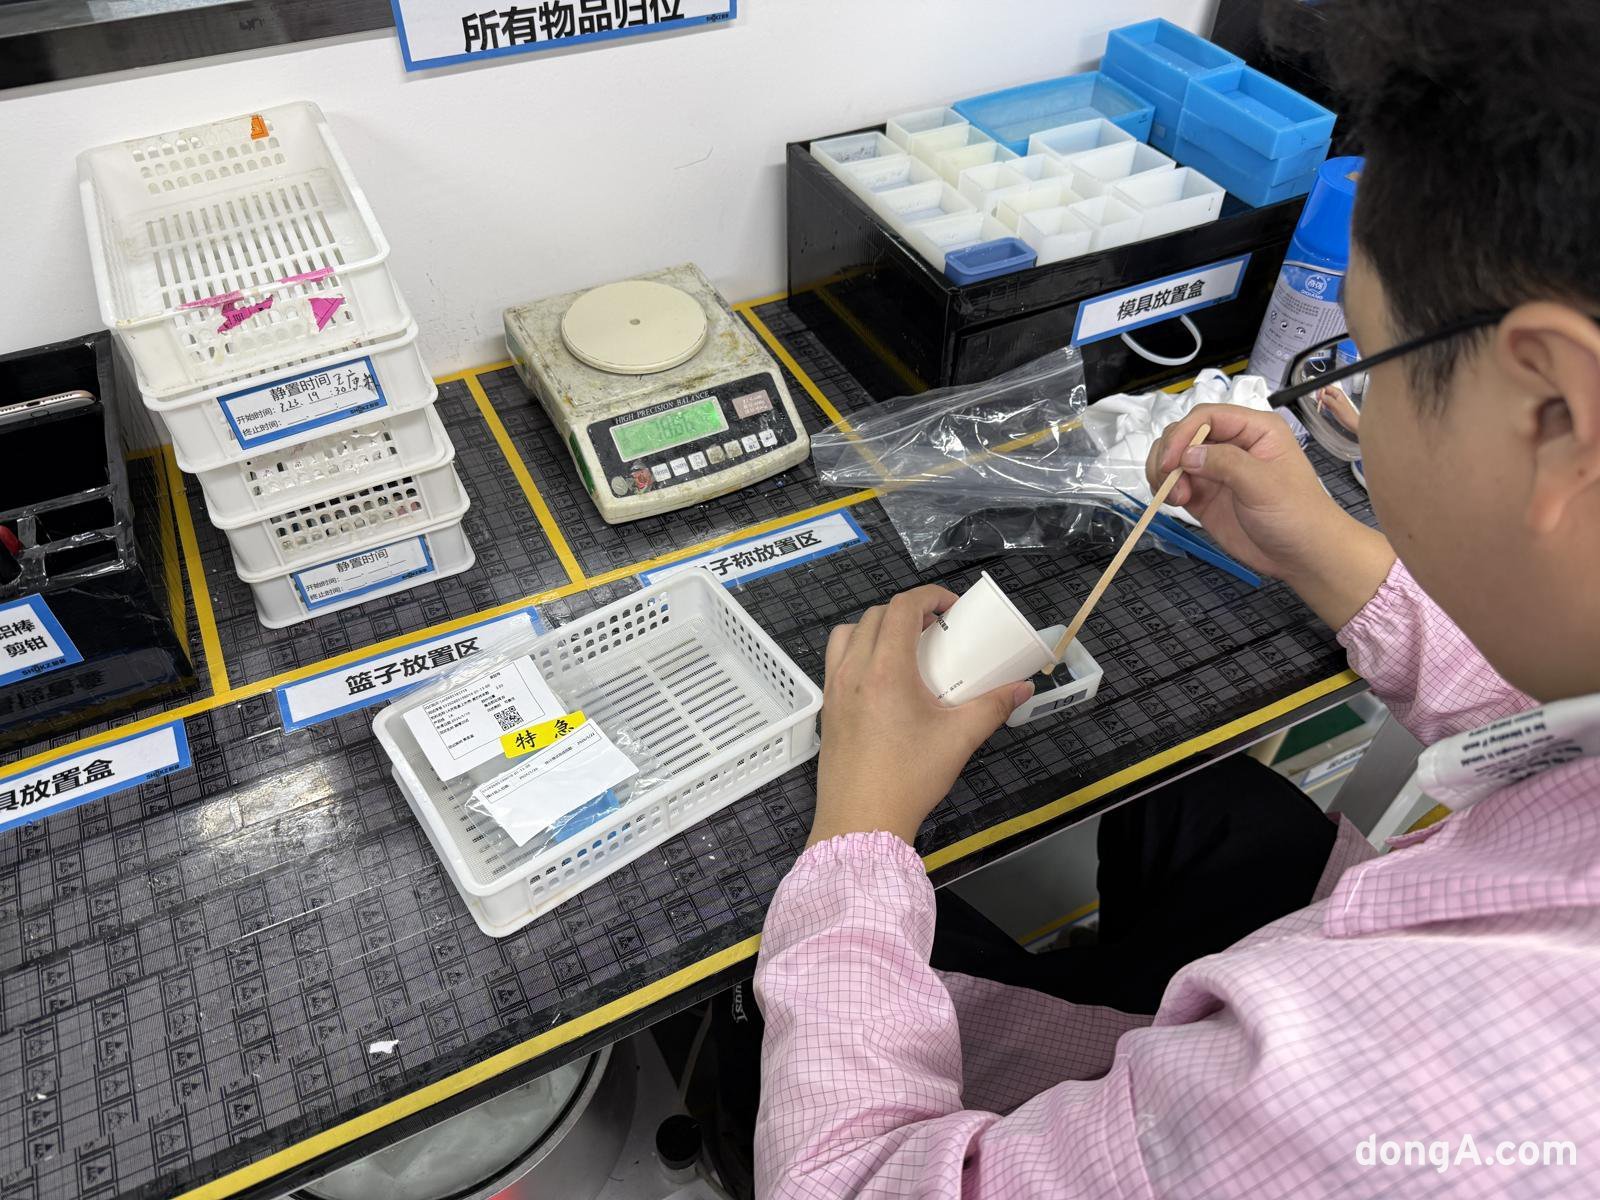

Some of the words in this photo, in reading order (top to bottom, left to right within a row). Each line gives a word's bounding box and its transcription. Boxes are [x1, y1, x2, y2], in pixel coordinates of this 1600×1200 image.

[1117, 279, 1205, 321] 模具放置盒
[269, 373, 331, 401] 静置时间
[615, 413, 634, 425] HIGH
[637, 402, 674, 418] PRECISION
[676, 391, 709, 408] BALANCE
[335, 548, 389, 573] 静置时间
[696, 530, 822, 576] 子称放置区
[3, 634, 48, 658] 剪钳
[346, 637, 483, 696] 篮子放置区
[516, 719, 574, 750] 特急
